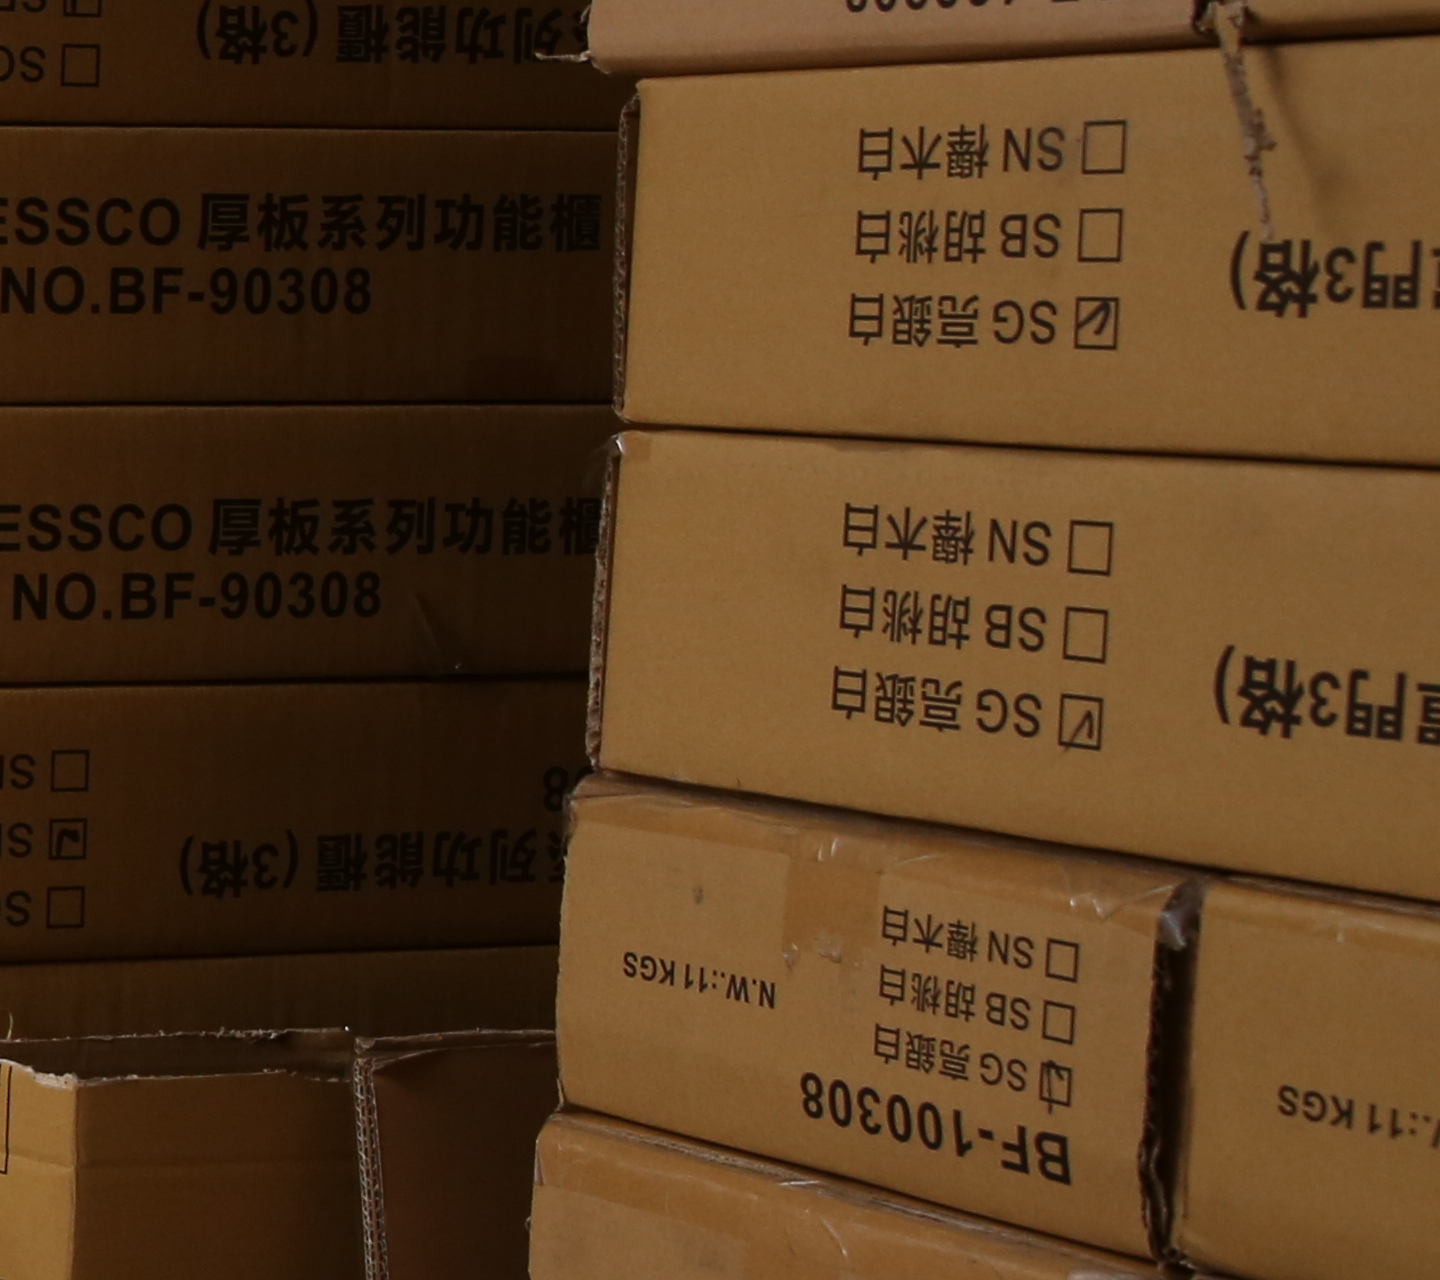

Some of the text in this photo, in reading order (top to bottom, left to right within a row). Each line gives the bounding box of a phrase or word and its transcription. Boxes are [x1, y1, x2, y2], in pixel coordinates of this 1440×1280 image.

[1003, 127, 1065, 172] SN
[197, 193, 602, 252] 厚板系列功能櫃
[856, 210, 1061, 264] SB 胡桃白
[1, 266, 371, 315] NO.BF-90308
[849, 293, 1057, 348] SG 亮銀白
[13, 571, 380, 620] NO.BF-90308
[179, 829, 298, 899] (3格)
[624, 952, 675, 986] KGS
[988, 931, 1034, 969] SN
[879, 964, 1031, 1030] SB 胡桃白
[874, 1023, 1027, 1092] SG 亮銀白
[801, 1073, 1071, 1185] BF-100308
[1278, 1085, 1354, 1129] KGS
